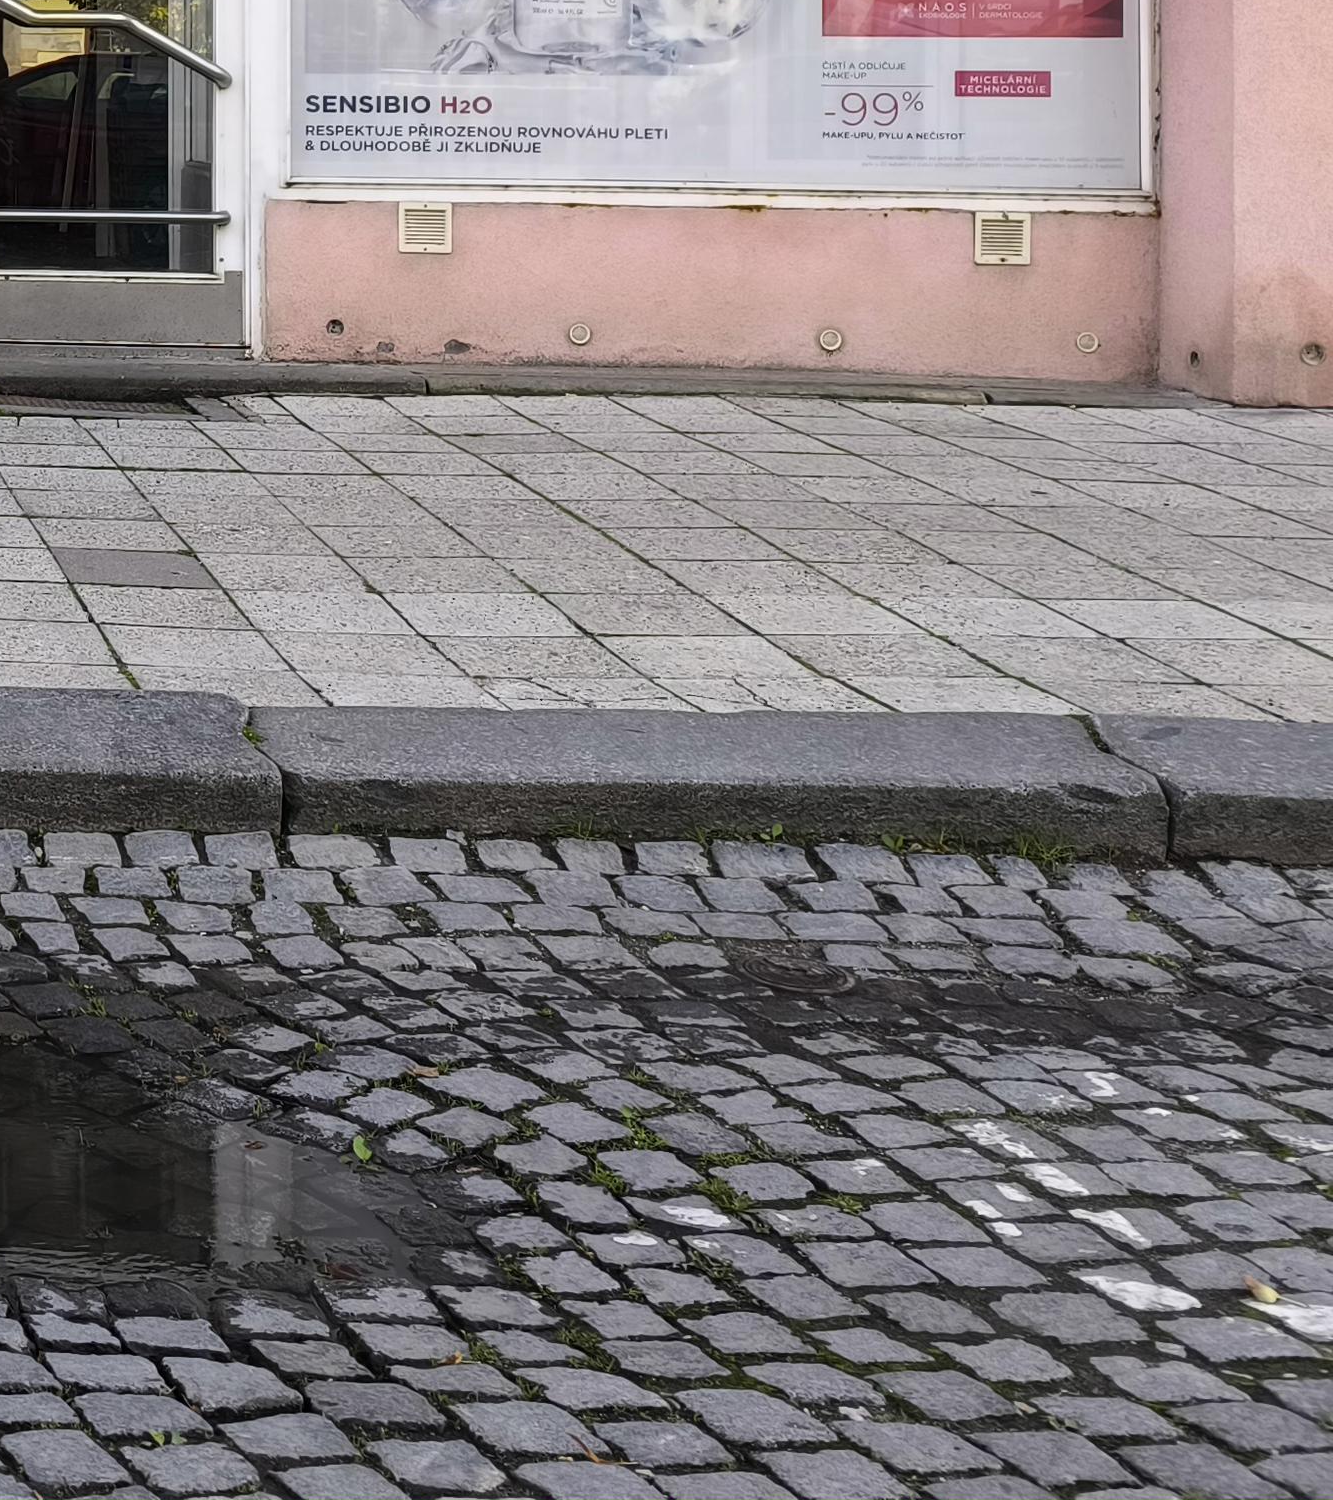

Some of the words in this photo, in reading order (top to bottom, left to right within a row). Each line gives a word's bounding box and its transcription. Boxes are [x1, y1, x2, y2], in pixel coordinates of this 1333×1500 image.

[918, 2, 967, 12] NAOS
[979, 11, 1043, 19] DERMATOLOGIE
[822, 60, 847, 70] ČISTÍ
[849, 62, 856, 70] A
[858, 60, 906, 71] ODLIČUJE
[822, 72, 867, 80] MAKE-UP
[969, 75, 1037, 85] MICELÁRNÍ
[960, 85, 1047, 95] TECHNOLOGIE
[305, 94, 431, 114] SENSIBIO
[440, 95, 493, 114] H2O
[305, 124, 403, 138] RESPEKTUJE
[408, 122, 512, 139] PŘIROZENOU
[517, 124, 620, 140] ROVNOVÁHU
[624, 127, 668, 140] PLETI
[878, 131, 904, 141] PYLU
[906, 131, 914, 141] A
[916, 130, 966, 141] NEČISTOT
[305, 140, 315, 151] &
[319, 138, 432, 152] DLOUHODOBĚ
[436, 140, 449, 152] JI
[454, 139, 542, 154] ZKLIDŇUJE
